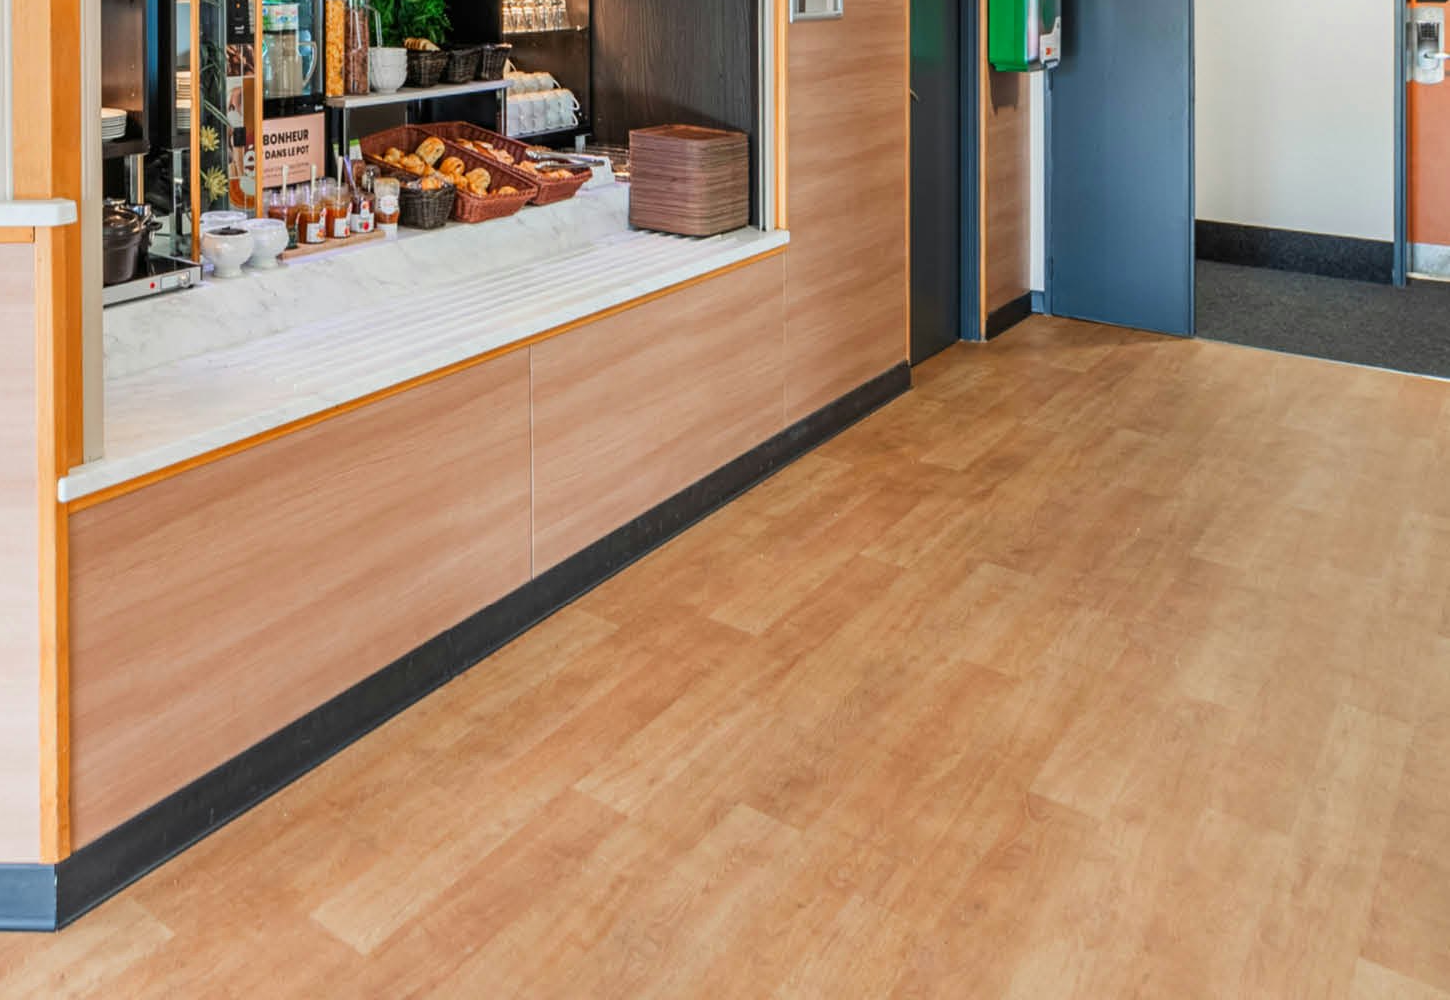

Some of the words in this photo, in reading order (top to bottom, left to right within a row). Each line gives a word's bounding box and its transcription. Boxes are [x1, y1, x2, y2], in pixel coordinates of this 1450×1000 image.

[263, 129, 309, 146] BONHEUR
[264, 148, 287, 160] DANS
[287, 146, 295, 157] LE
[296, 145, 309, 155] POT
